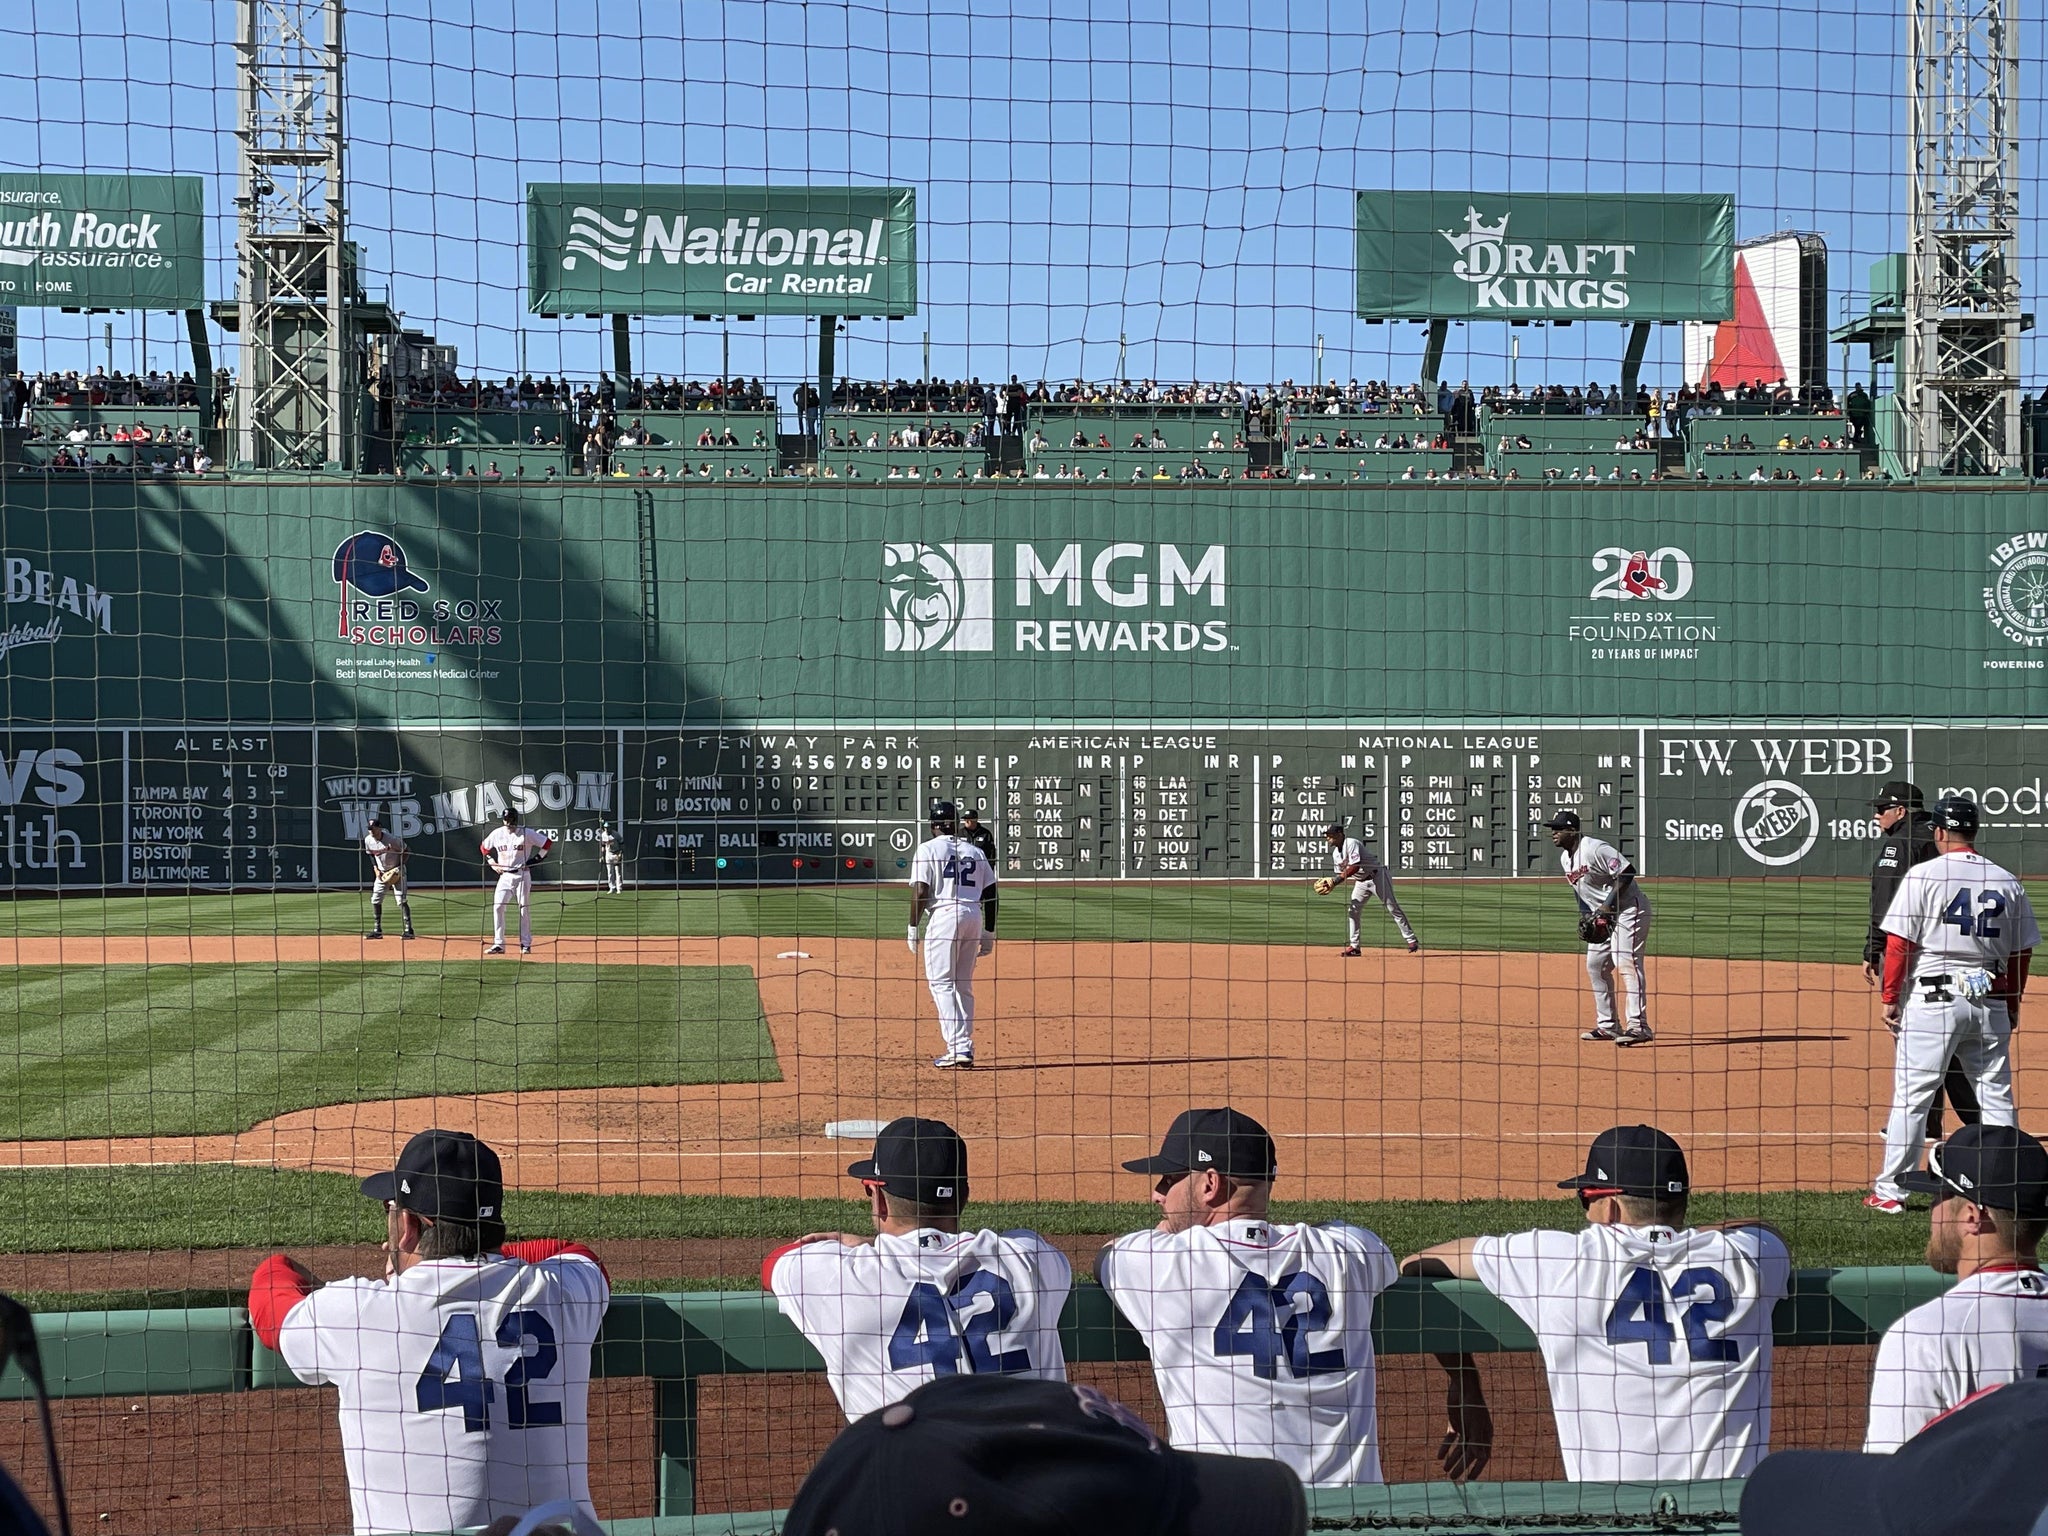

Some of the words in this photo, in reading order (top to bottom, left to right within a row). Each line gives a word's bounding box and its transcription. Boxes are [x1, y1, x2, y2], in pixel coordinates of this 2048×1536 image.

[0, 212, 61, 248] uth
[69, 212, 161, 249] Rock
[637, 215, 886, 266] National
[1453, 241, 1636, 283] DRAFT
[36, 281, 72, 292] HOME
[725, 272, 772, 294] Car
[781, 272, 873, 294] Rental
[1475, 277, 1631, 310] KINGS
[1989, 532, 2047, 567] IBEW
[1016, 543, 1226, 607] MGM
[3, 557, 113, 635] BEAM
[351, 600, 420, 621] RED
[433, 600, 502, 621] SOX
[1983, 587, 2004, 628] NECA
[1613, 612, 1641, 622] RED
[1646, 612, 1673, 622] SOX
[351, 626, 502, 645] SCHOLARS
[1016, 620, 1228, 651] REWARDS
[1569, 626, 1716, 641] FOUNDATION
[2002, 626, 2048, 647] CONT
[1591, 649, 1603, 659] 20
[1608, 649, 1640, 659] YEARS
[1644, 649, 1657, 659] OF
[1661, 649, 1699, 659] IMPACT
[374, 658, 396, 667] Lahey
[1983, 661, 2045, 669] POWERING
[336, 669, 355, 678] Beth
[358, 669, 382, 678] Israel
[383, 669, 431, 678] Deaconess
[433, 669, 468, 678] Medical
[469, 669, 500, 678] Center
[175, 739, 199, 751] AL
[212, 739, 268, 751] EAST
[699, 736, 818, 749] FENWAY
[844, 736, 919, 749] PARK
[1028, 737, 1129, 749] AMERICAN
[1142, 736, 1216, 749] LEAGUE
[1359, 737, 1453, 749] NATIONAL
[1464, 737, 1538, 749] LEAGUE
[897, 755, 912, 769] 10
[930, 755, 940, 769] R
[955, 755, 964, 768] H
[977, 755, 986, 768] E
[1750, 738, 1893, 776] WEBB
[222, 765, 232, 778] W
[247, 765, 257, 778] L
[268, 765, 288, 778] GB
[325, 779, 371, 797] WHO
[375, 777, 413, 795] BUT
[685, 777, 722, 790] MINN
[931, 776, 940, 789] 6
[978, 776, 986, 789] 0
[1034, 776, 1062, 789] NYY
[1159, 776, 1187, 789] LAA
[1303, 776, 1321, 789] SF
[1400, 776, 1414, 788] 56
[1429, 776, 1452, 788] PHI
[1528, 776, 1541, 788] 53
[1557, 776, 1581, 788] CIN
[132, 787, 177, 800] TAMPA
[183, 787, 208, 800] BAY
[222, 787, 231, 800] 4
[247, 787, 257, 800] 3
[1008, 792, 1020, 805] 28
[1035, 792, 1062, 805] BAL
[1133, 792, 1144, 805] 51
[1159, 792, 1188, 805] TEX
[1271, 792, 1284, 804] 34
[1297, 792, 1326, 805] CLE
[1400, 792, 1413, 804] 49
[1428, 792, 1452, 804] MIA
[1528, 792, 1541, 804] 26
[1555, 792, 1583, 804] LAD
[430, 771, 614, 834] MASON
[656, 798, 667, 811] 18
[675, 798, 731, 811] BOSTON
[132, 807, 202, 819] TORONTO
[222, 807, 231, 819] 4
[247, 807, 257, 819] 3
[1035, 809, 1062, 821] OAK
[1133, 809, 1146, 821] 29
[1159, 809, 1188, 821] DET
[1271, 809, 1284, 821] 27
[1301, 809, 1323, 821] ARI
[1426, 808, 1456, 821] CHC
[1529, 808, 1541, 820] 30
[1755, 807, 1799, 839] WEBB
[132, 827, 162, 839] NEW
[166, 827, 204, 839] YORK
[222, 827, 231, 839] 4
[247, 827, 257, 839] 3
[1034, 825, 1062, 837] TOR
[1163, 825, 1183, 837] KC
[1271, 825, 1285, 837] 40
[1297, 825, 1331, 837] NYM
[1427, 825, 1455, 836] COL
[1665, 819, 1724, 841] Since
[1828, 819, 1882, 840] 1866
[655, 834, 674, 847] AT
[678, 834, 704, 847] BAT
[719, 834, 759, 847] BALL
[778, 833, 833, 847] STRIKE
[841, 833, 875, 847] OUT
[132, 847, 191, 860] BOSTON
[222, 847, 231, 859] 3
[247, 847, 257, 859] 3
[1039, 842, 1058, 854] TB
[1133, 842, 1144, 854] 17
[1158, 842, 1189, 854] HOU
[1271, 842, 1285, 854] 32
[1297, 841, 1328, 854] WSH
[1401, 841, 1414, 853] 39
[1427, 841, 1455, 853] STL
[1033, 858, 1063, 870] CWS
[1160, 857, 1188, 870] SEA
[1271, 858, 1285, 869] 23
[1301, 857, 1324, 870] PIT
[1428, 857, 1453, 869] MIL
[132, 867, 209, 880] BALTIMORE
[247, 866, 256, 879] 5
[272, 866, 281, 879] 2
[943, 855, 976, 887] 42
[1943, 887, 2006, 938] 42
[1605, 1266, 1741, 1365] 42
[888, 1269, 1032, 1380] 42
[1214, 1270, 1346, 1380] 42
[415, 1309, 562, 1433] 42
